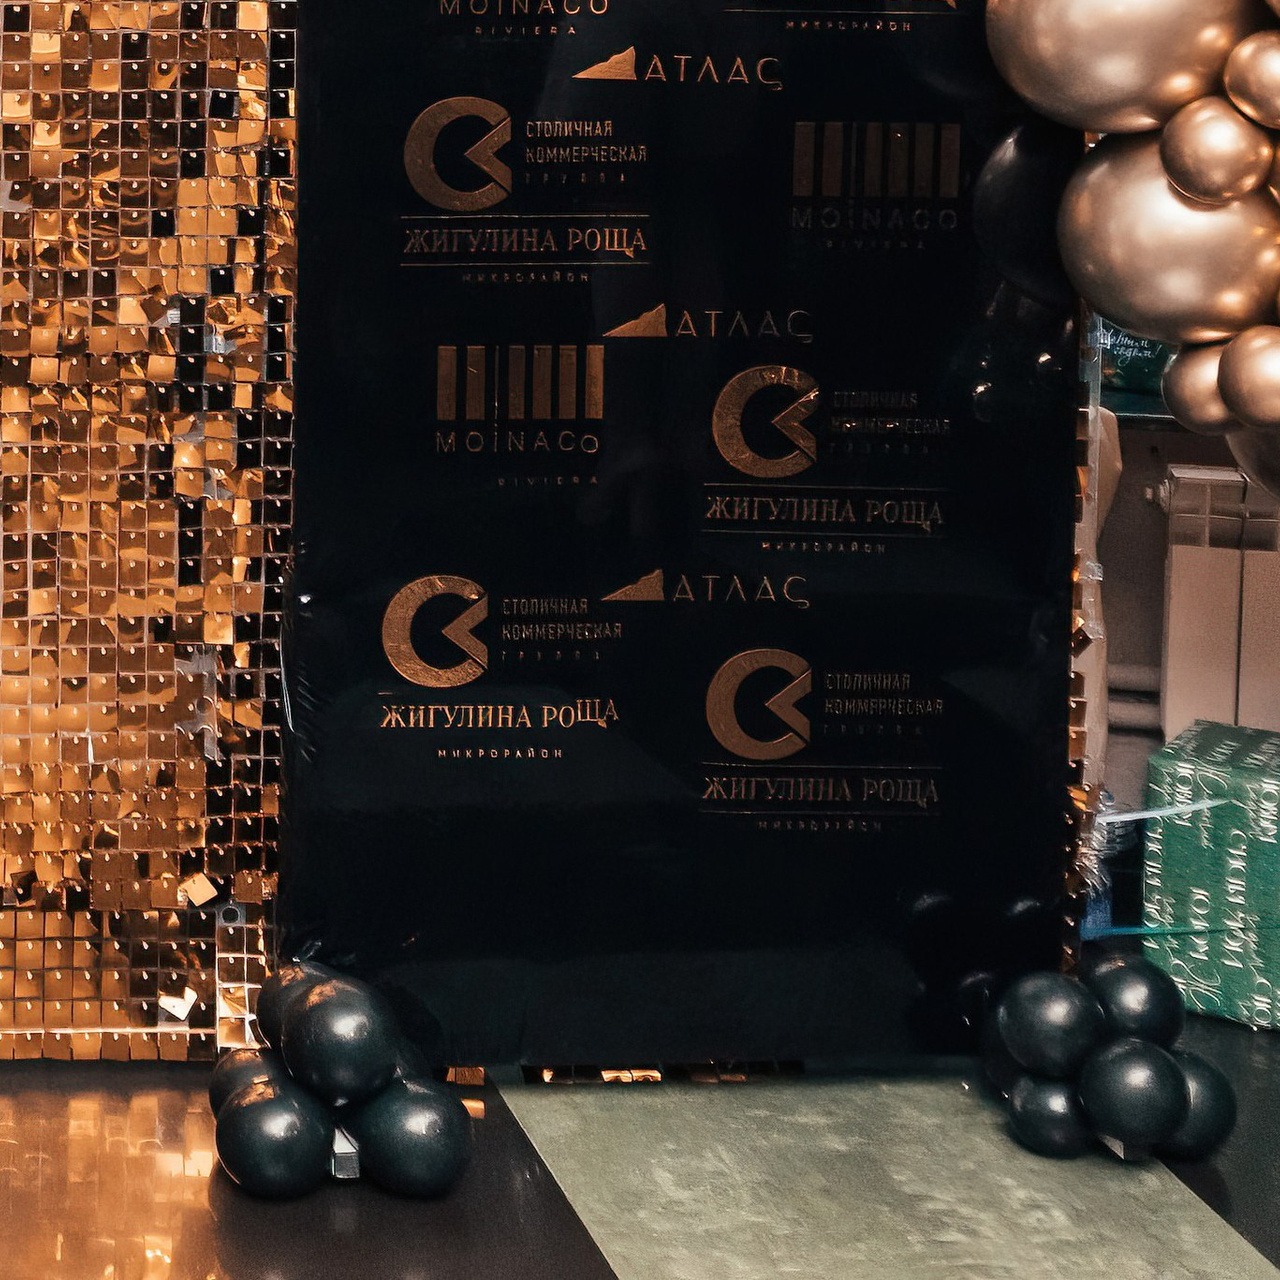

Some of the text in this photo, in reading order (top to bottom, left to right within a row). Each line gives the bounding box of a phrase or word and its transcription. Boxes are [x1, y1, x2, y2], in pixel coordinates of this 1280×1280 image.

[474, 25, 577, 36] RIVIERA
[525, 120, 614, 138] СТОЛИЧНАЯ
[525, 145, 648, 163] КОММЕРЧЕСКАЯ
[403, 227, 648, 259] ЖИГУЛИНА РОЩА
[703, 495, 944, 534] ЖИГУЛИНА РОЩА
[501, 598, 588, 615] СТОЛИЧНАЯ
[380, 698, 620, 730] ЖИГУЛИНА РОЩА
[437, 748, 564, 759] МИКРОРАЙОН
